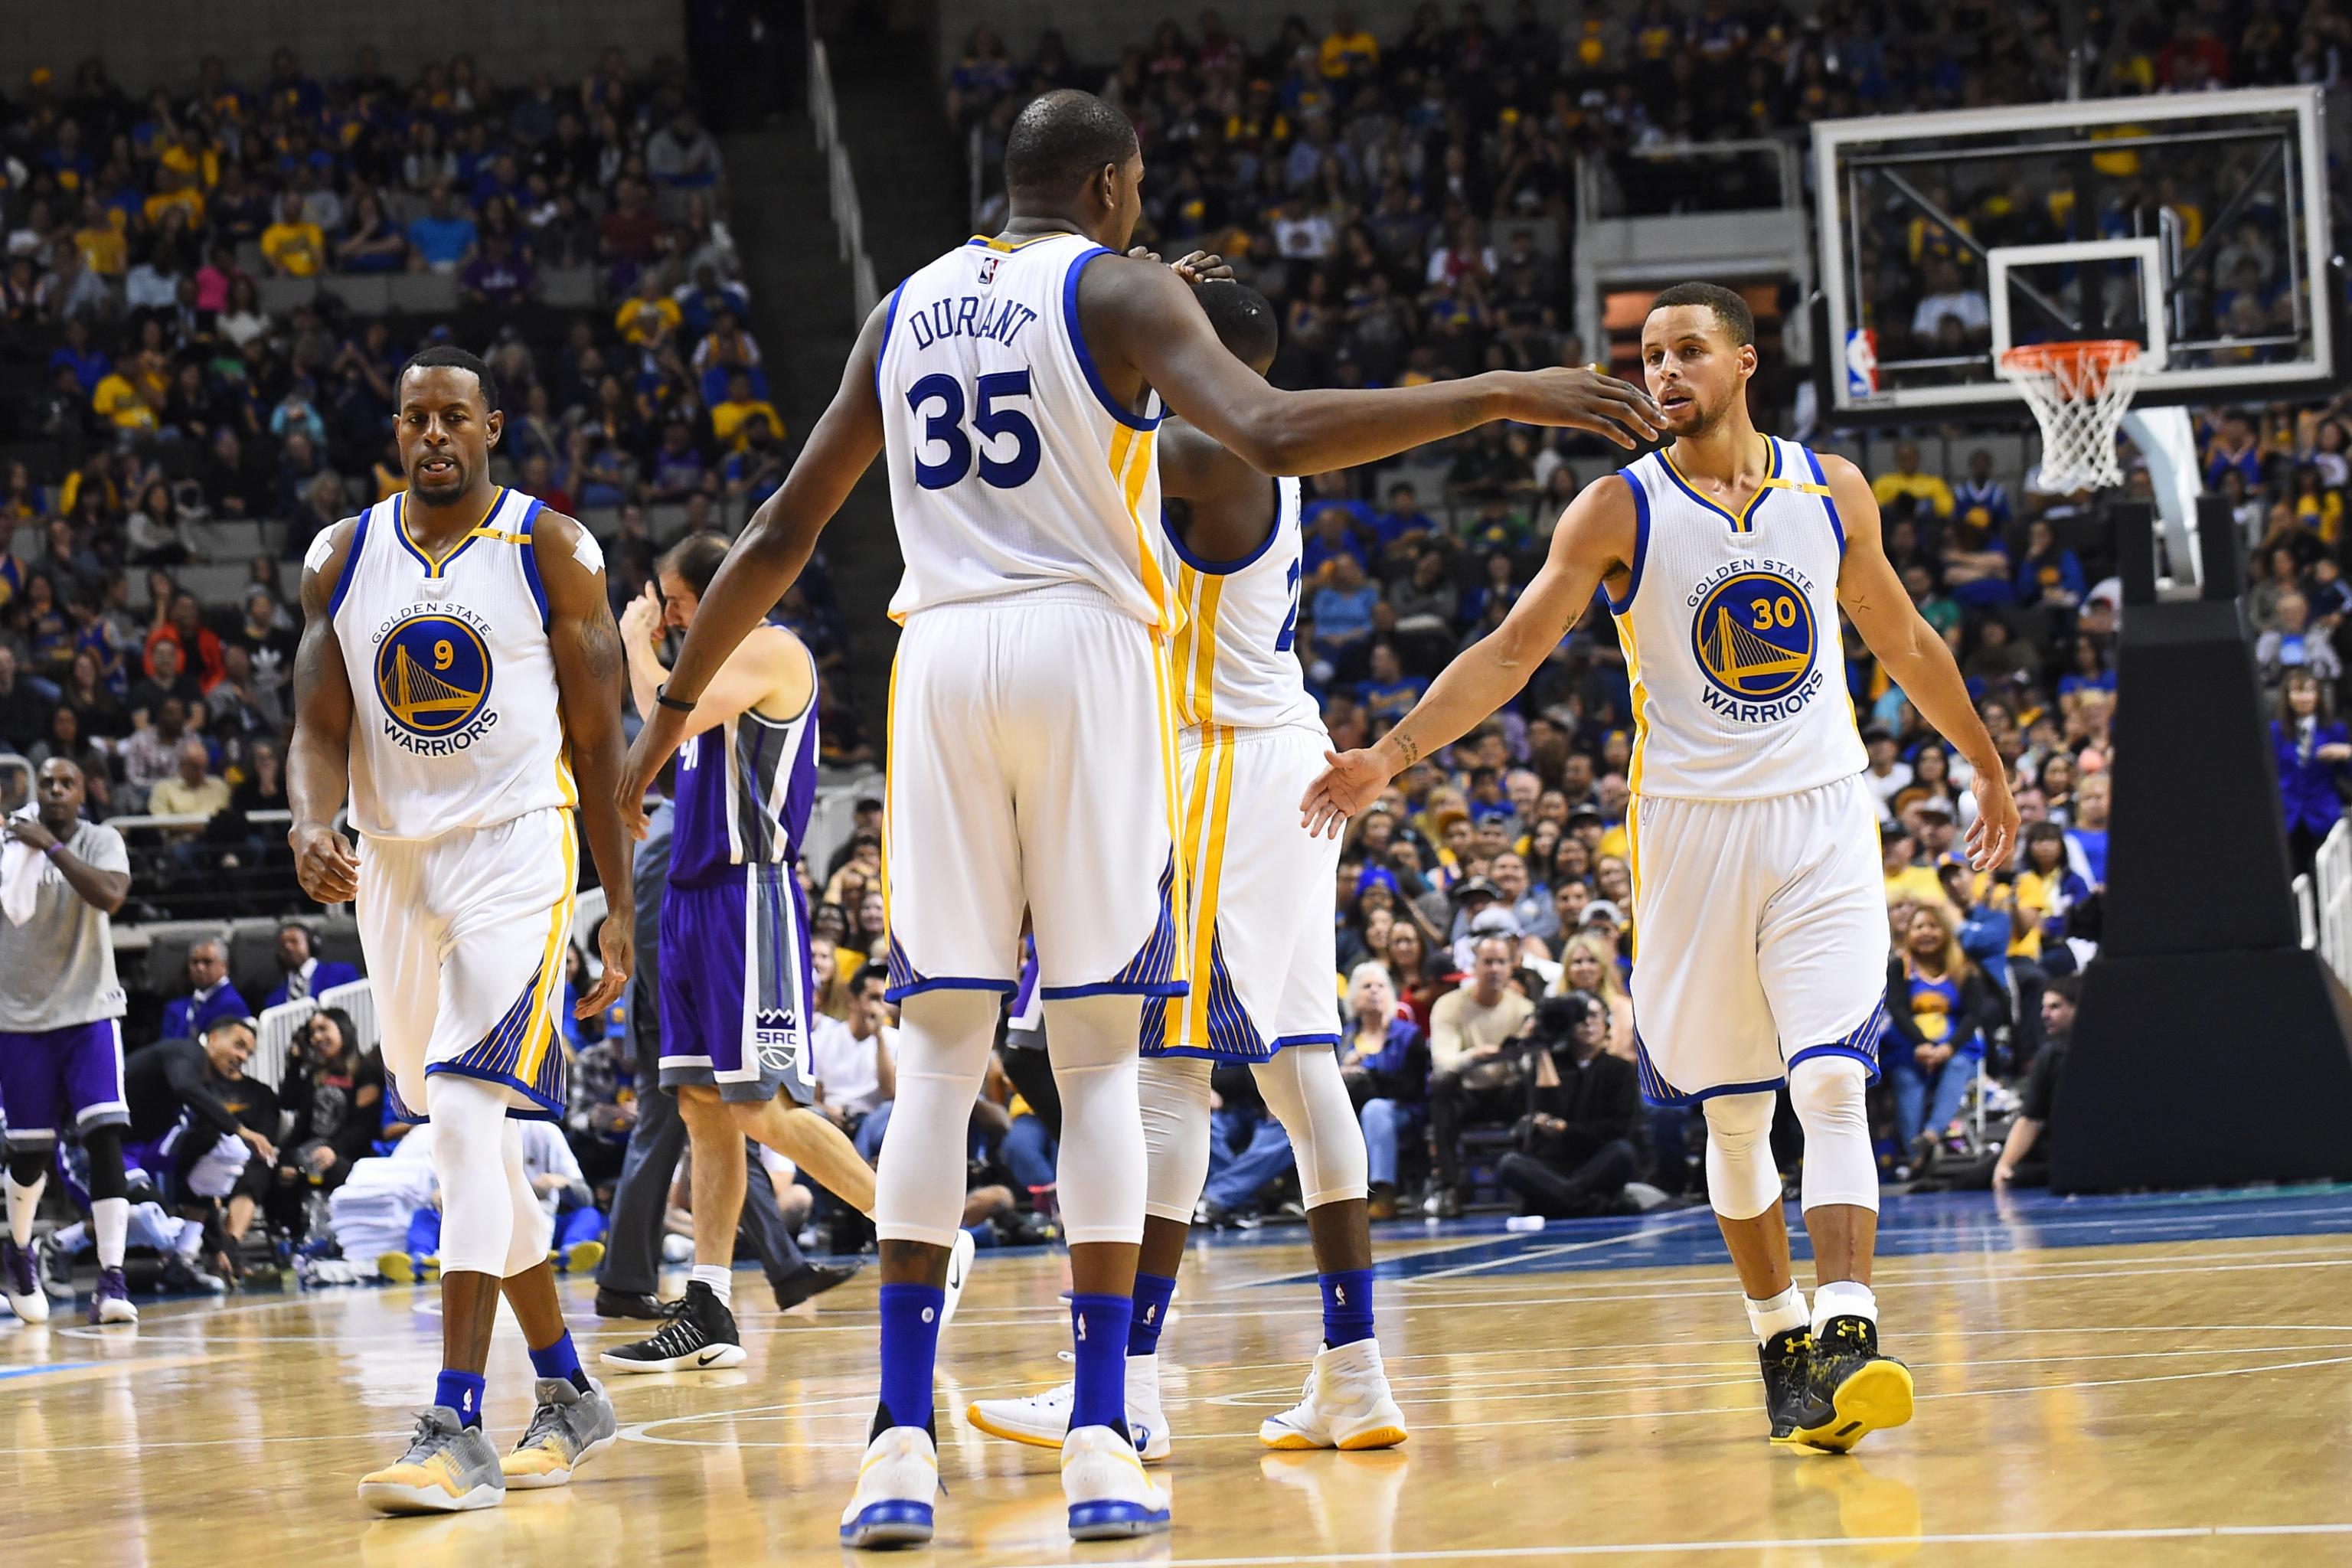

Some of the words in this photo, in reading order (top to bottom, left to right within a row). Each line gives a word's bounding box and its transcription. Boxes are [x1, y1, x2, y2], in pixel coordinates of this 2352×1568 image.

[909, 296, 1037, 351] DURANT
[905, 364, 1041, 490] 35
[1687, 559, 1755, 607] GOLDEN
[1763, 560, 1815, 594] STATE
[372, 603, 437, 644] GOLDEN
[444, 603, 492, 635] STATE
[1750, 596, 1796, 630] 30
[434, 640, 453, 670] 9
[1702, 669, 1823, 723] WARRIORS
[384, 708, 498, 756] WARRIORS
[756, 1032, 796, 1044] SAC
